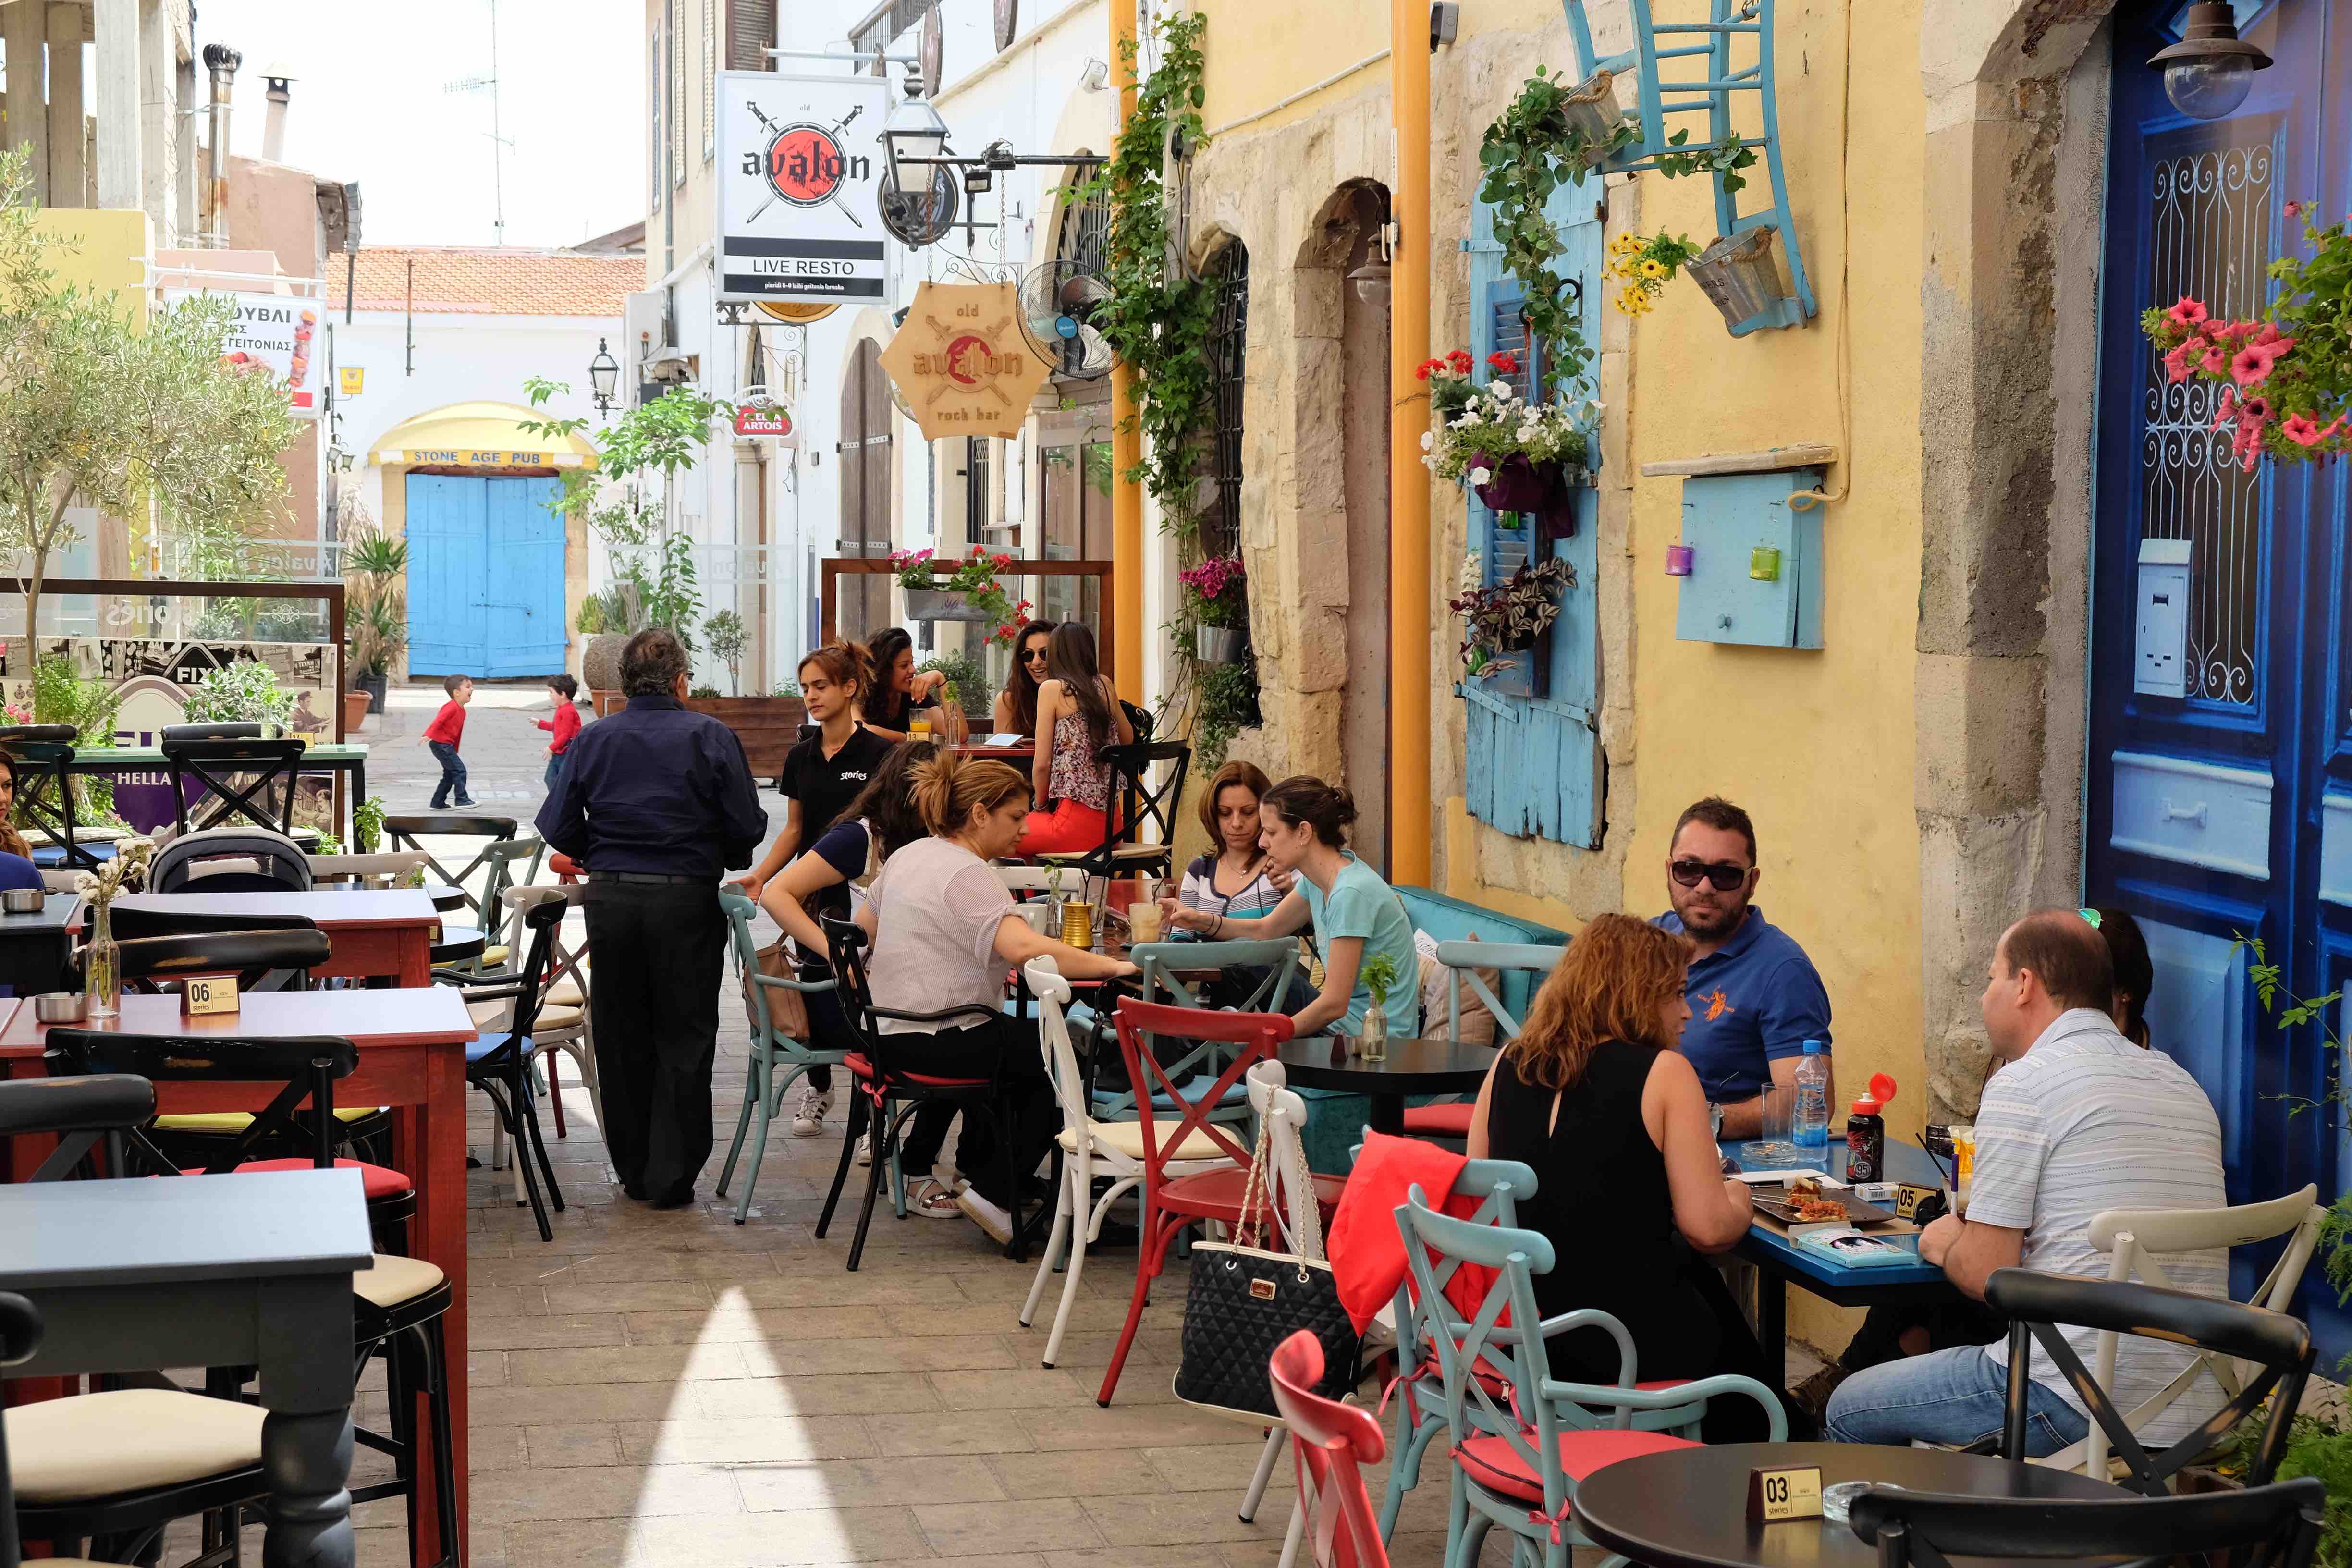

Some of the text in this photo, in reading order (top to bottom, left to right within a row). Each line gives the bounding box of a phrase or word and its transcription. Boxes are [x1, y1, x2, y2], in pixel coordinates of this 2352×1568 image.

[742, 140, 870, 183] avalon
[753, 259, 855, 275] LIVE RESTO
[956, 304, 979, 317] old
[913, 342, 1023, 378] avalon
[937, 407, 1001, 421] rock bar
[743, 422, 783, 430] ARTOIS
[415, 451, 540, 464] STONE AGE PUB
[177, 667, 214, 683] FIX
[117, 772, 172, 786] HELLA
[840, 771, 867, 781] stories
[191, 983, 210, 1003] 06
[1857, 1165, 1869, 1176] 95
[1900, 1189, 1915, 1208] 05
[1766, 1477, 1788, 1503] 03
[1768, 1506, 1788, 1515] stories
